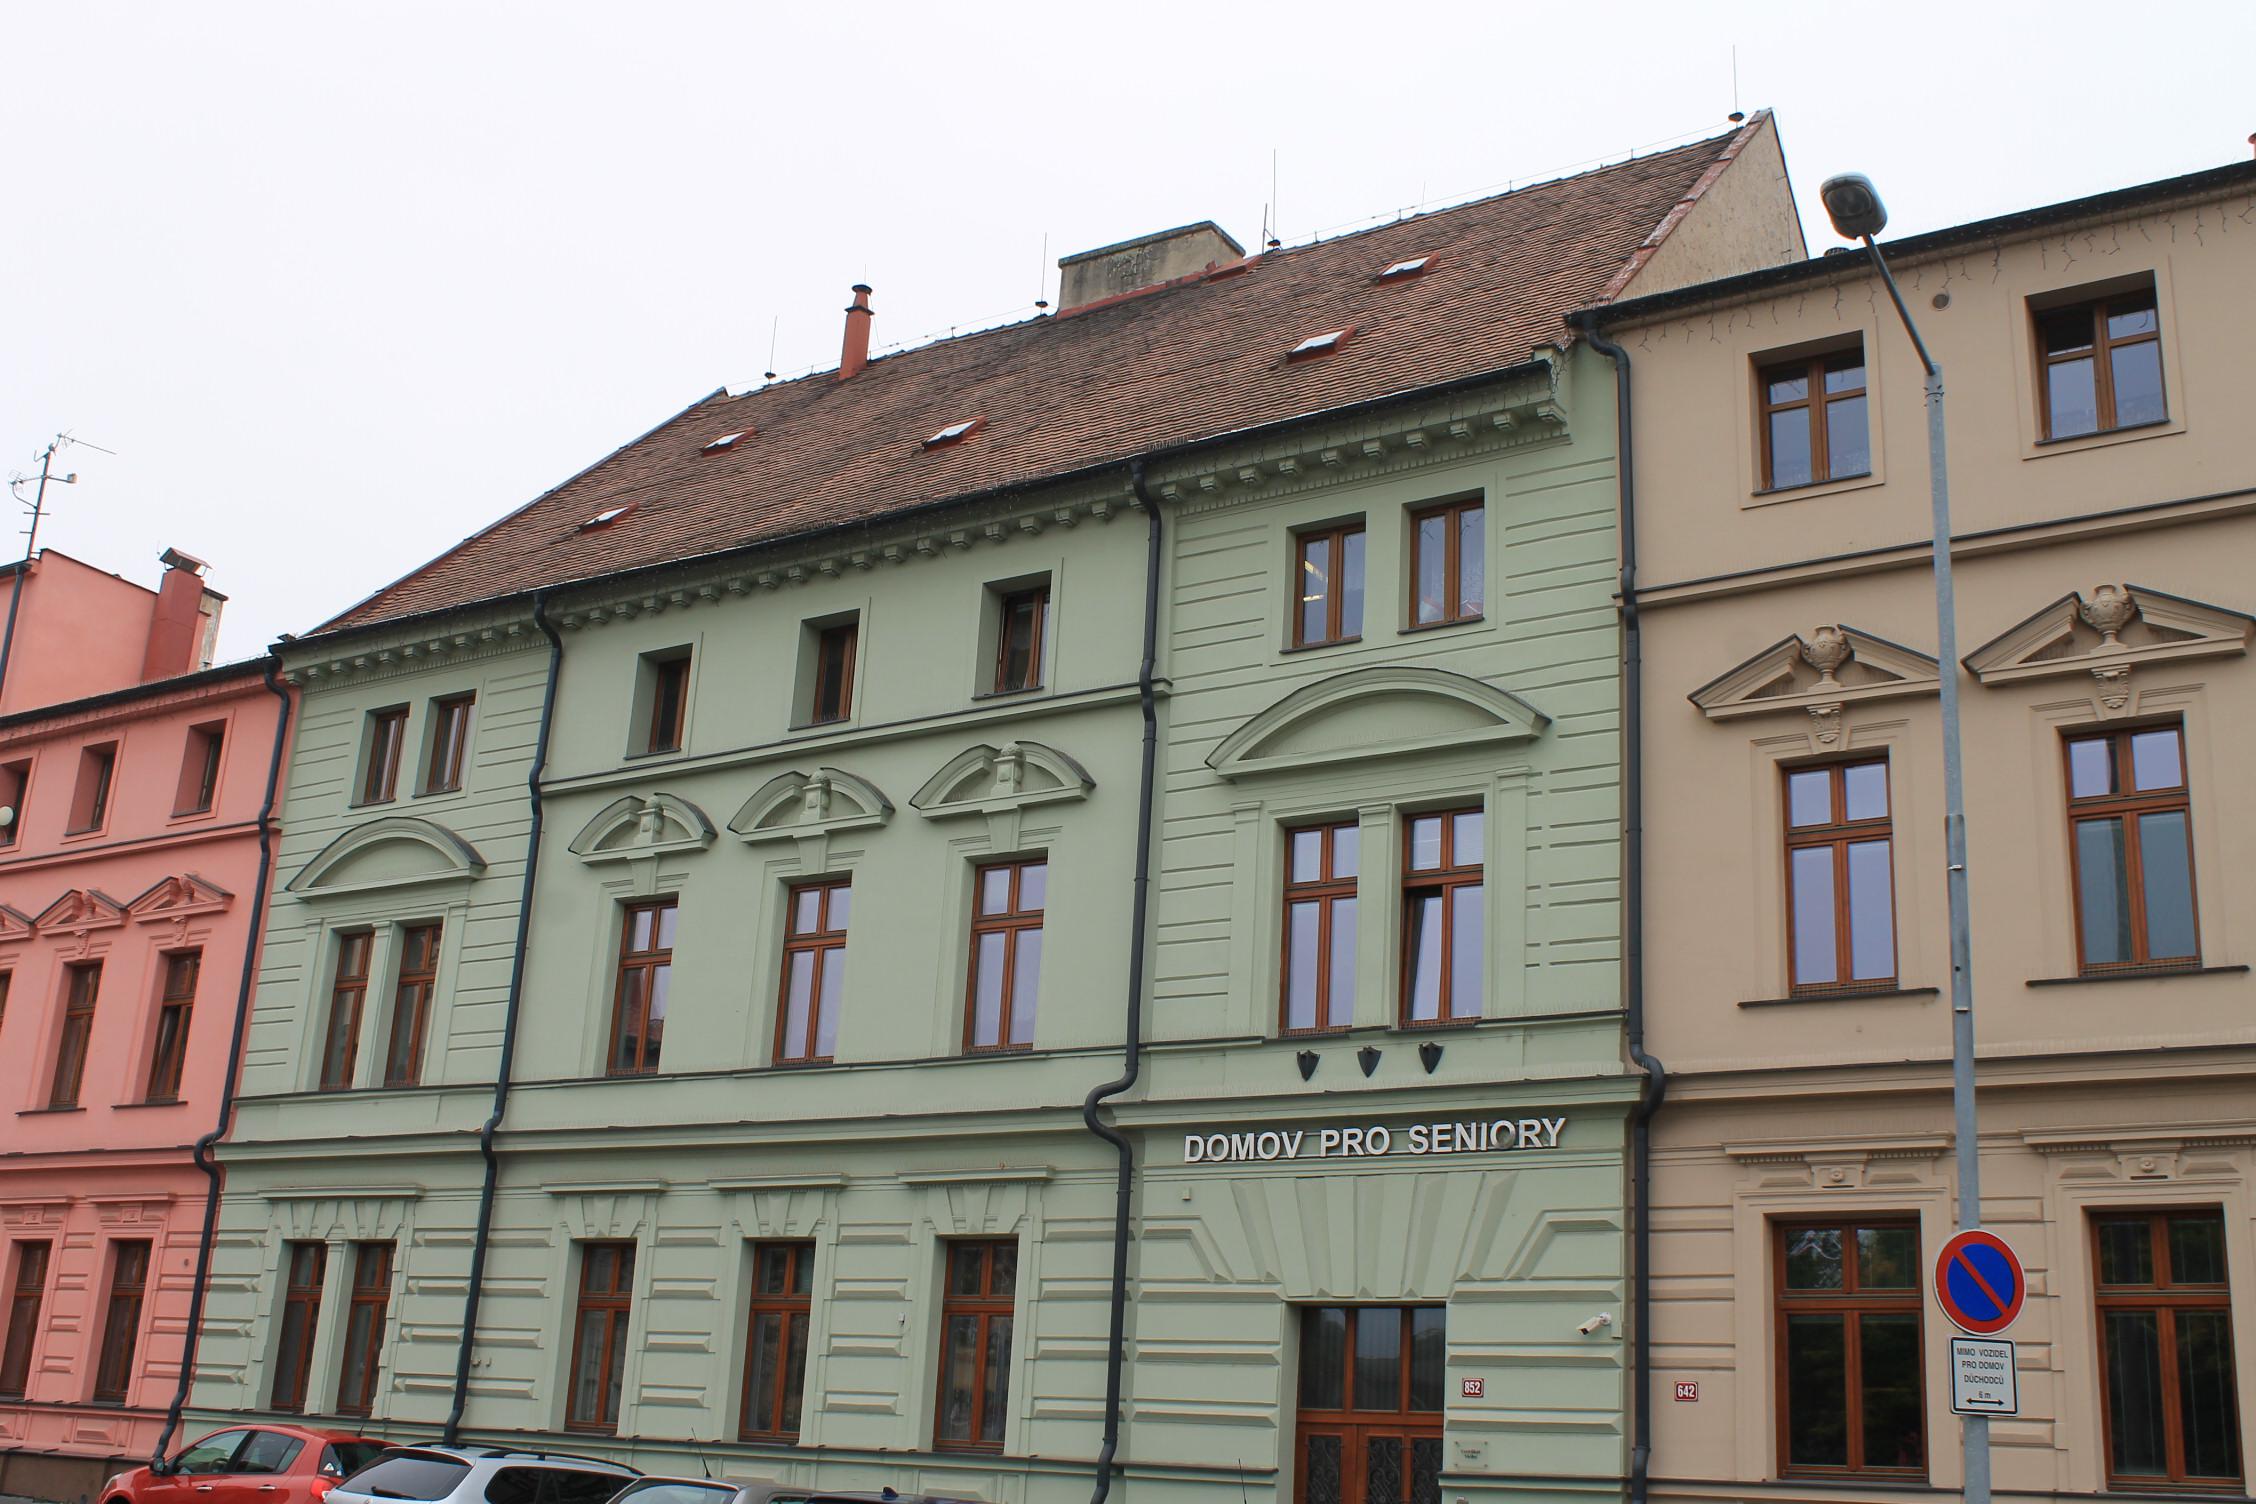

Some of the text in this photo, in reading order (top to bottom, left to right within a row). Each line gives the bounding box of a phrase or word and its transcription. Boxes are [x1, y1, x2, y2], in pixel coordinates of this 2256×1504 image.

[1184, 1117, 1566, 1163] DOMOV PRO SENIORY
[1957, 1347, 2009, 1359] MIMO VOZIDEL
[1961, 1360, 2004, 1370] PRO DOMOV
[1464, 1381, 1481, 1394] 852
[1677, 1384, 1695, 1398] 642
